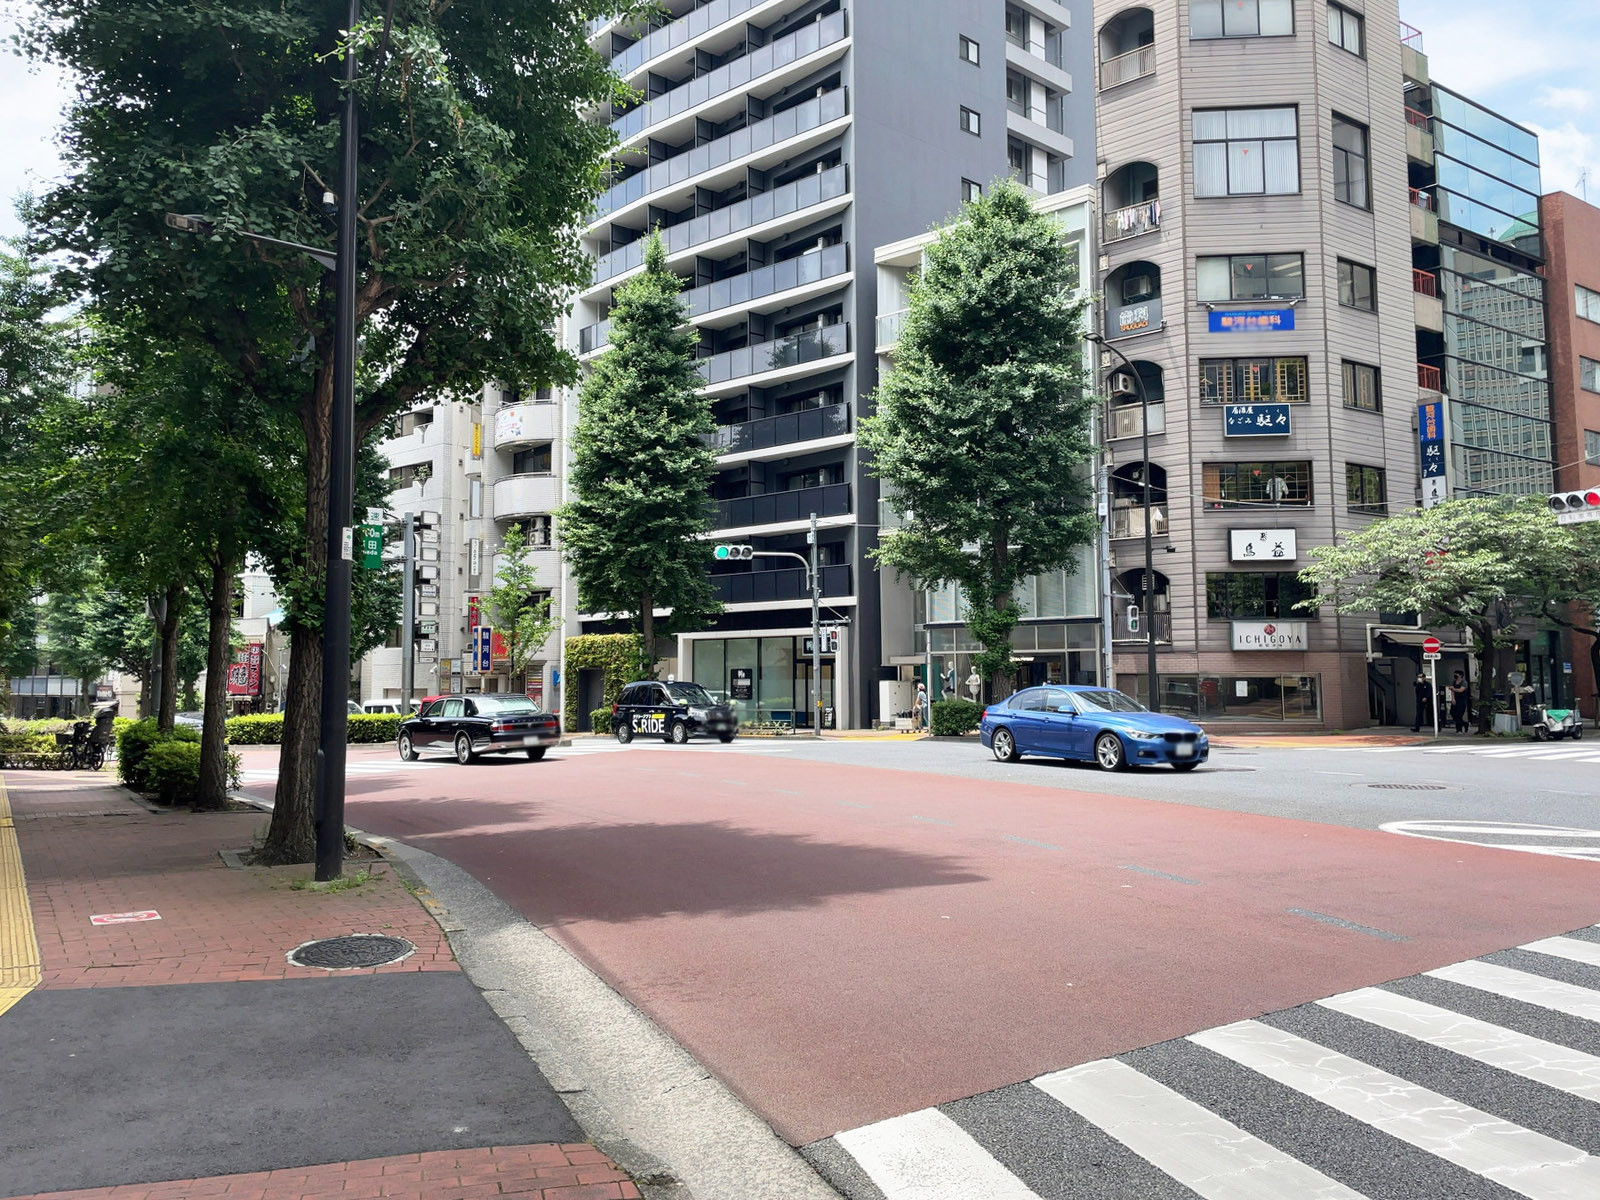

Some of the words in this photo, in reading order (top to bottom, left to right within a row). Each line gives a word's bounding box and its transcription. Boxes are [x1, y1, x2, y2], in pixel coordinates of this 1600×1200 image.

[1232, 406, 1254, 415] 居酒屋
[1228, 417, 1252, 425] なごみ
[1239, 634, 1302, 644] ICHIGOYA
[482, 631, 490, 668] 駿河台
[632, 719, 666, 733] S.RIDE
